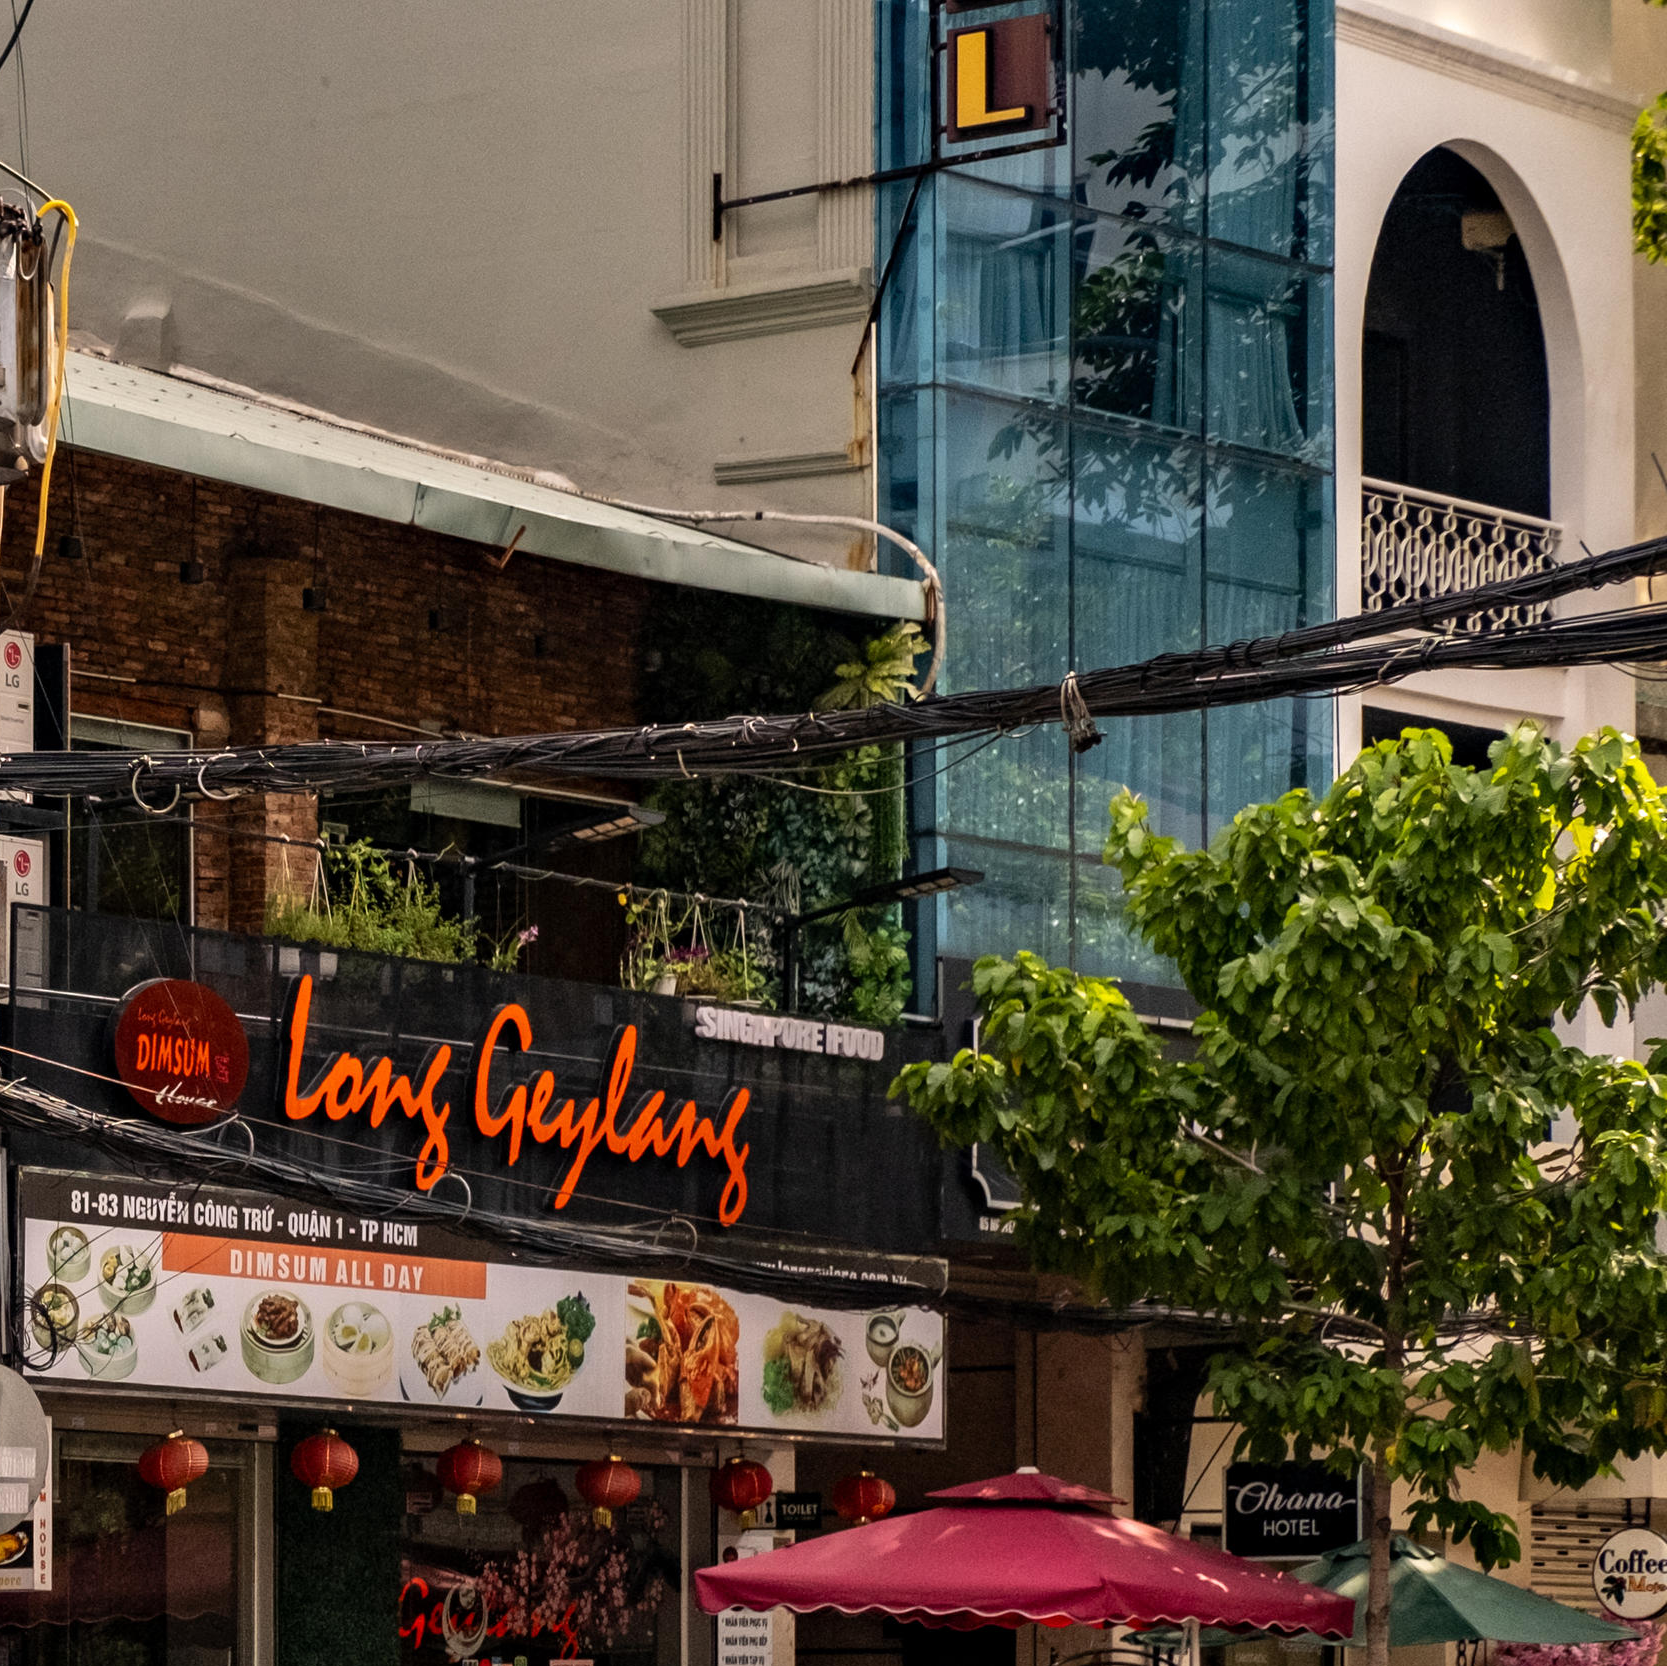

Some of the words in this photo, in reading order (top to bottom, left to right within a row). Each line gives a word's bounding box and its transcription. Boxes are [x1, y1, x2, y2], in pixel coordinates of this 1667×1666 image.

[6, 672, 20, 689] LG
[15, 882, 30, 897] LG
[695, 1005, 824, 1053] SINGAPORE
[825, 1023, 885, 1061] FOOD
[135, 1032, 210, 1079] DIMSUM
[155, 1080, 218, 1109] House
[284, 974, 451, 1191] Long
[474, 1003, 750, 1228] Geylang
[71, 1190, 119, 1219] 81-83
[123, 1190, 189, 1225] NGUYỄN
[193, 1199, 238, 1231] CÔNG
[242, 1204, 273, 1233] TRỨ
[288, 1209, 331, 1244] QUẬN
[336, 1219, 343, 1240] 1
[360, 1219, 380, 1243] TP
[383, 1222, 418, 1247] HCM
[230, 1248, 328, 1283] DIMSUM
[335, 1259, 375, 1287] ALL
[382, 1263, 425, 1291] DAY
[781, 1502, 819, 1516] TOILET
[1227, 1481, 1357, 1515] Ohana
[1262, 1518, 1321, 1537] HOTEL
[1598, 1548, 1667, 1574] Coffee
